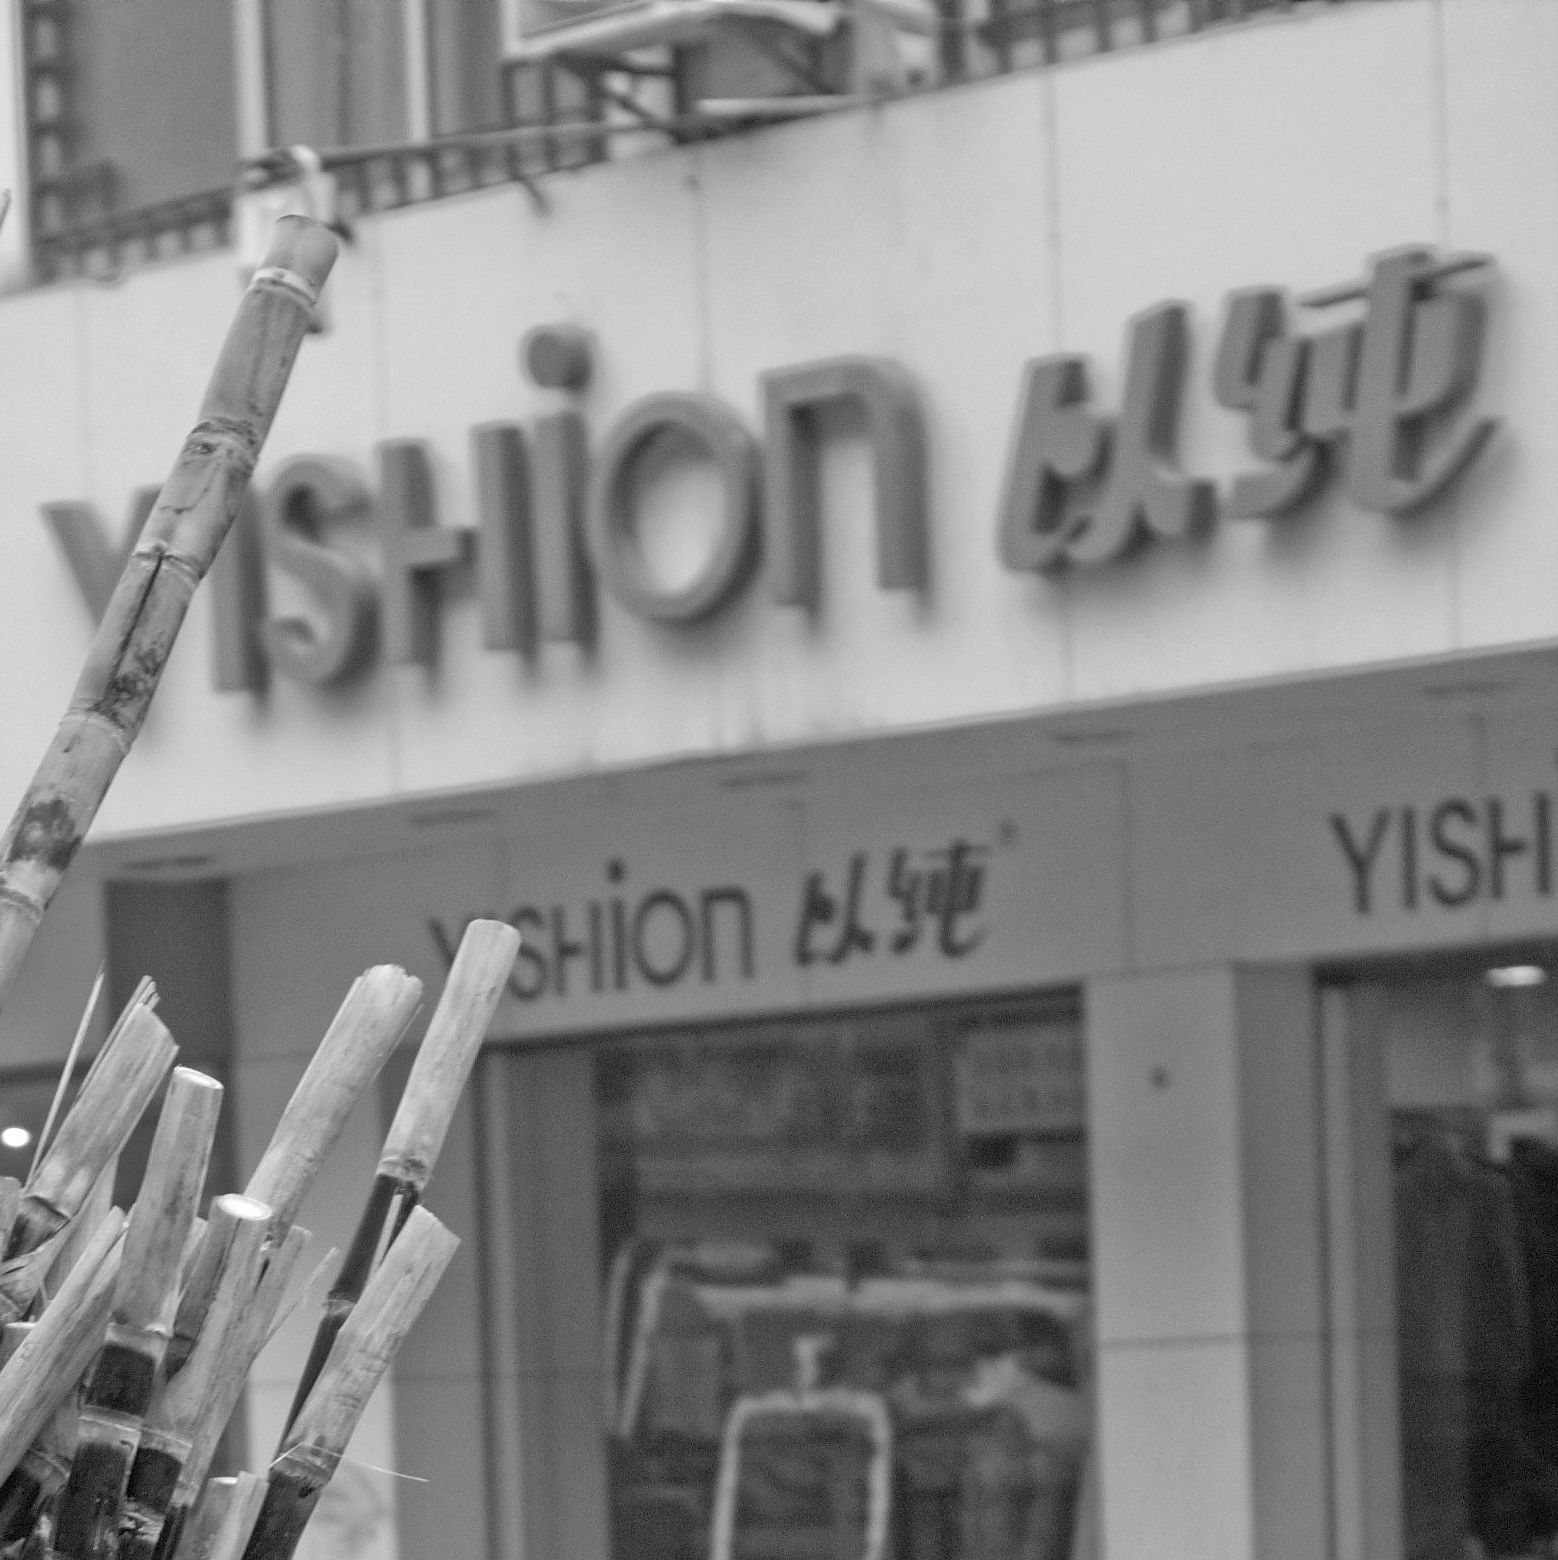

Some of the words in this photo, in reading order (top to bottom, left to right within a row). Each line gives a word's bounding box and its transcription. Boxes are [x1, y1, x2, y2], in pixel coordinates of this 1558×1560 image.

[998, 245, 1502, 576] 以纯
[429, 857, 754, 1000] SHion
[797, 840, 992, 965] 以纯
